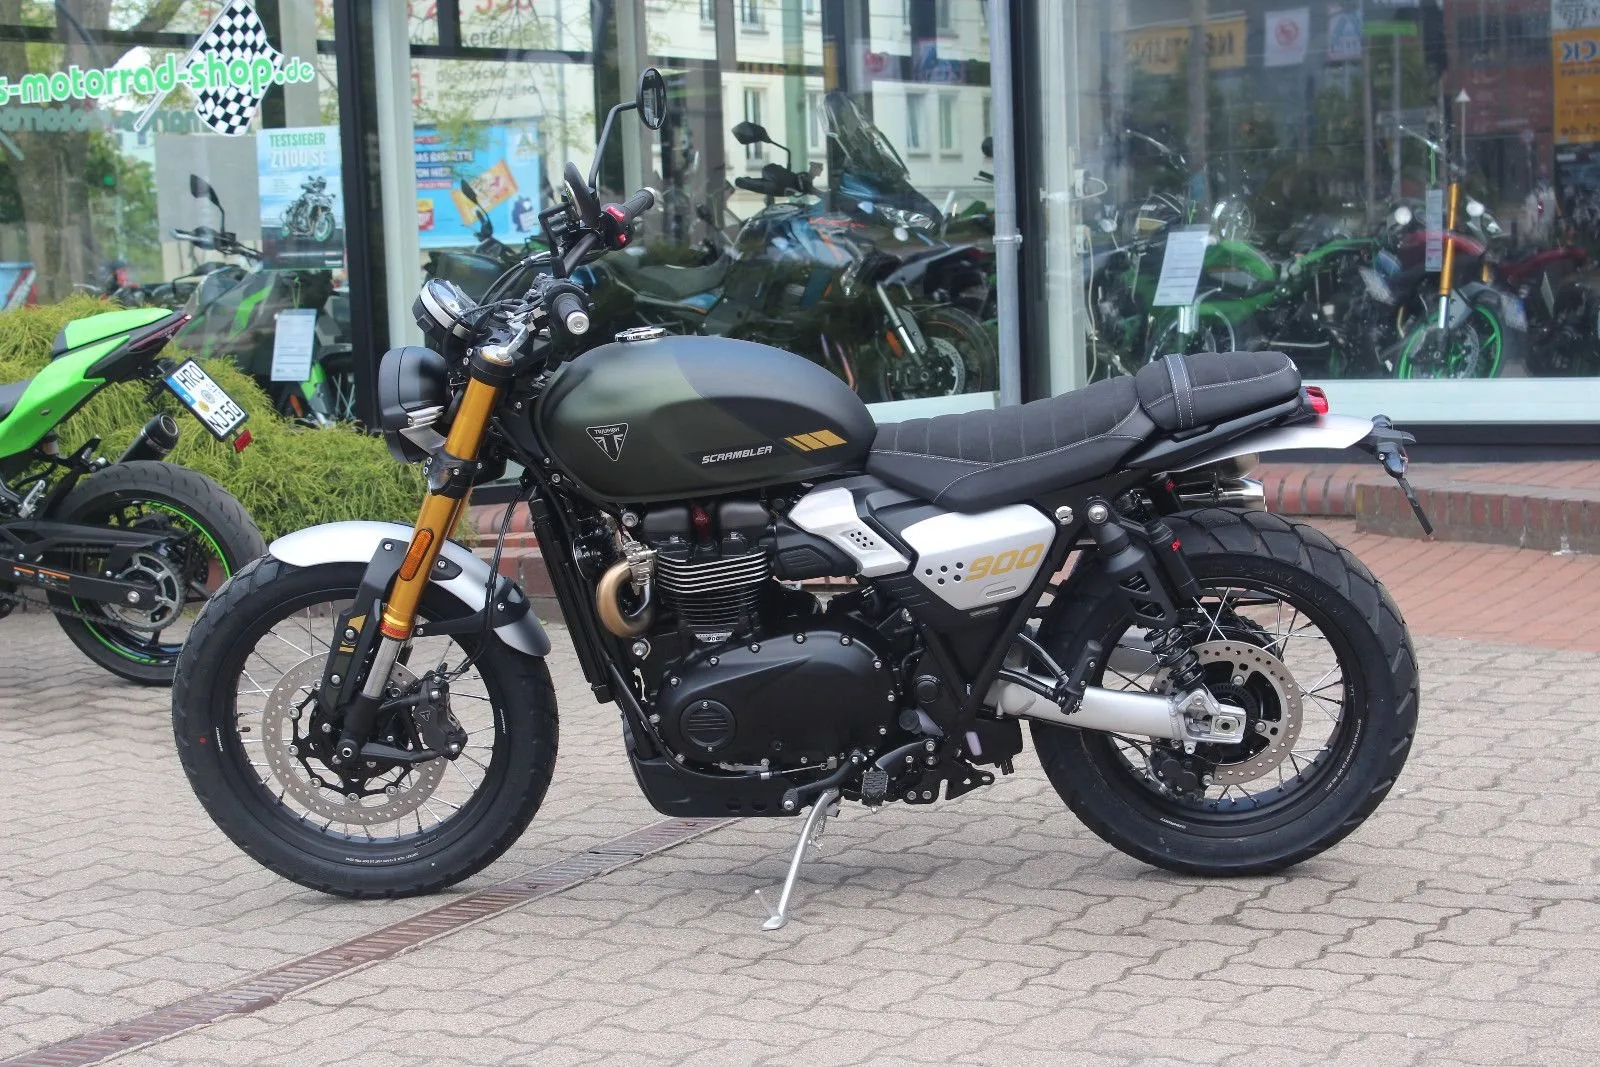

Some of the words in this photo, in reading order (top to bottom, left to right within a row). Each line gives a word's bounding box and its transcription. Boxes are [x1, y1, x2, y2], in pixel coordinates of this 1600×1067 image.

[269, 132, 326, 148] TESTSIEGER
[175, 364, 205, 391] HRO
[594, 427, 620, 436] TRIUMPH
[701, 445, 773, 464] SCRAMBLER
[964, 543, 1045, 583] 900
